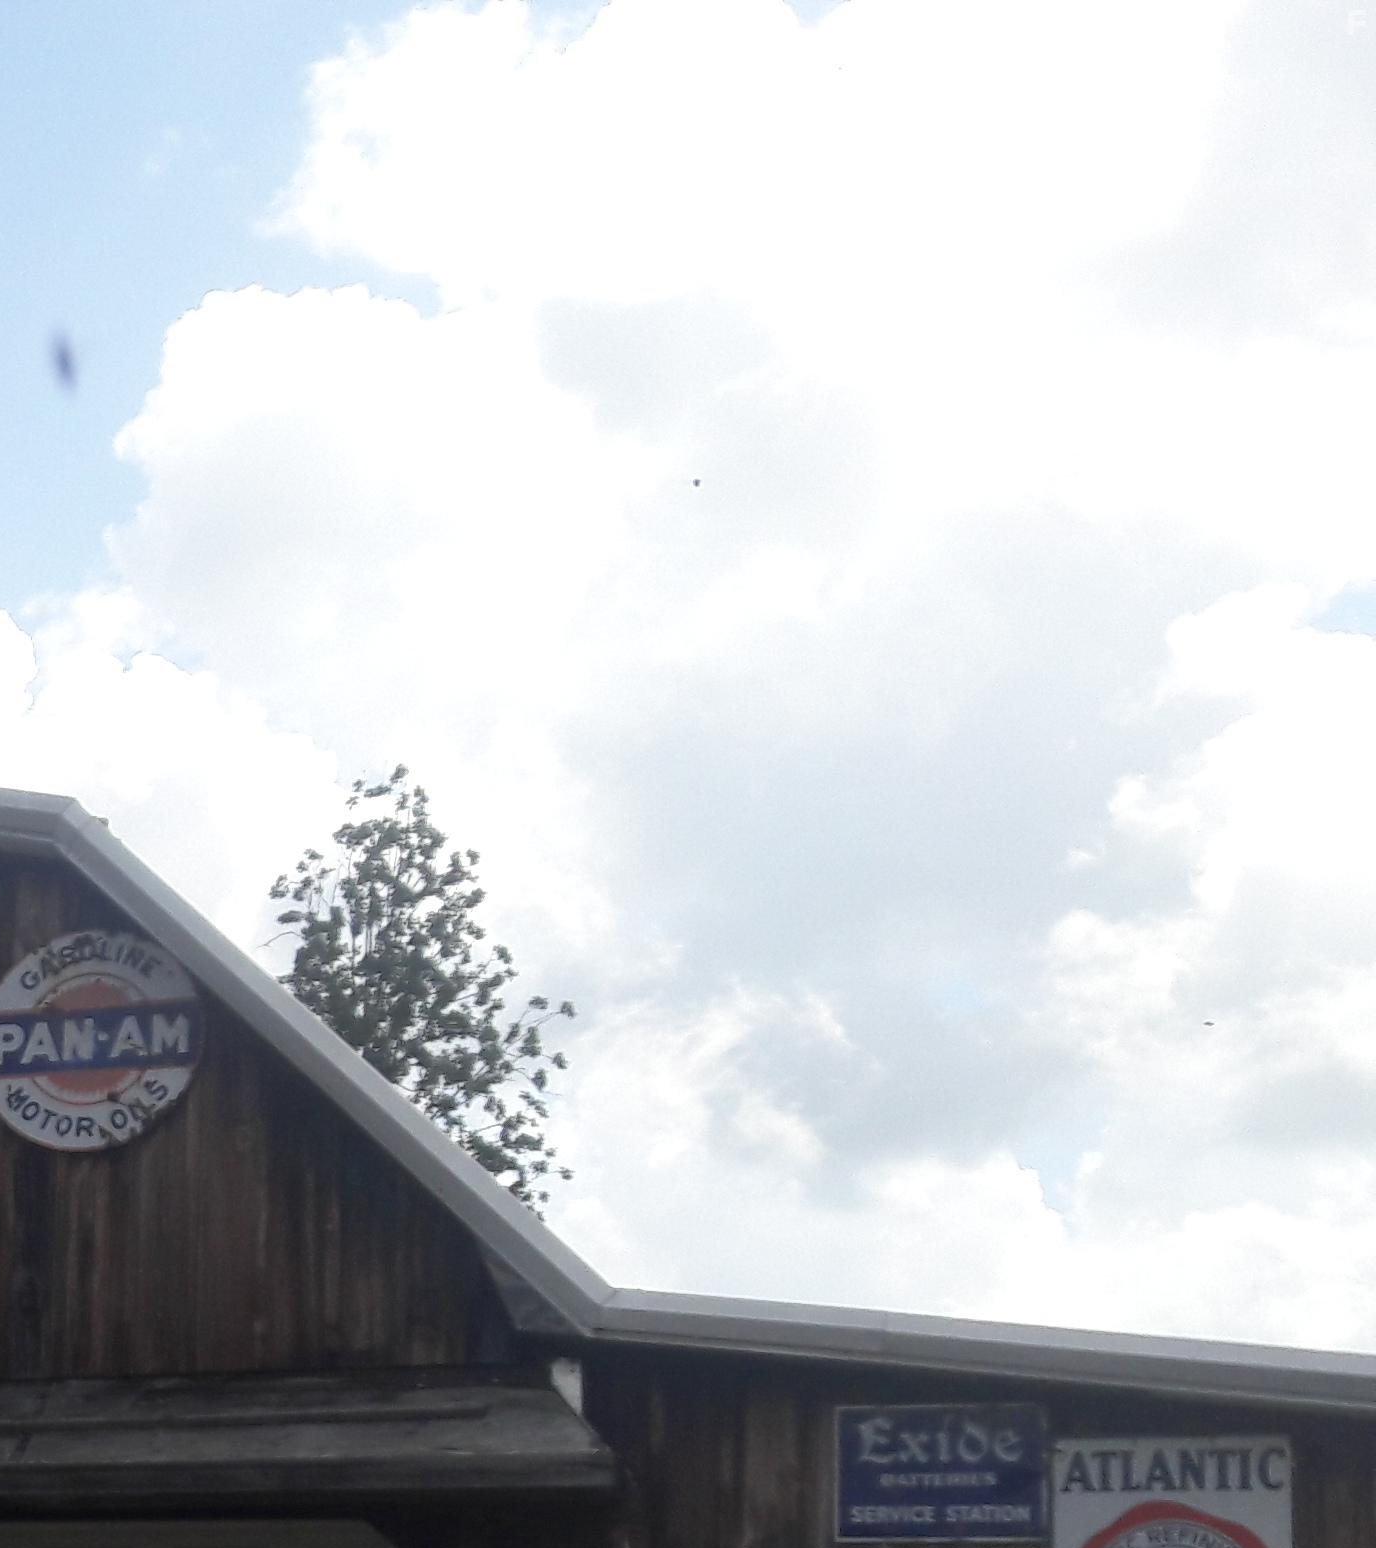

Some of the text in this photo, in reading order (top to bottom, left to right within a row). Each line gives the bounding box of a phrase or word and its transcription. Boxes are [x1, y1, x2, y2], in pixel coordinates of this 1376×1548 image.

[7, 1087, 98, 1137] MOTOR
[859, 1416, 1024, 1463] Exide
[1059, 1448, 1290, 1492] ATLANTIC
[850, 1505, 1032, 1522] SERVICE STATION
